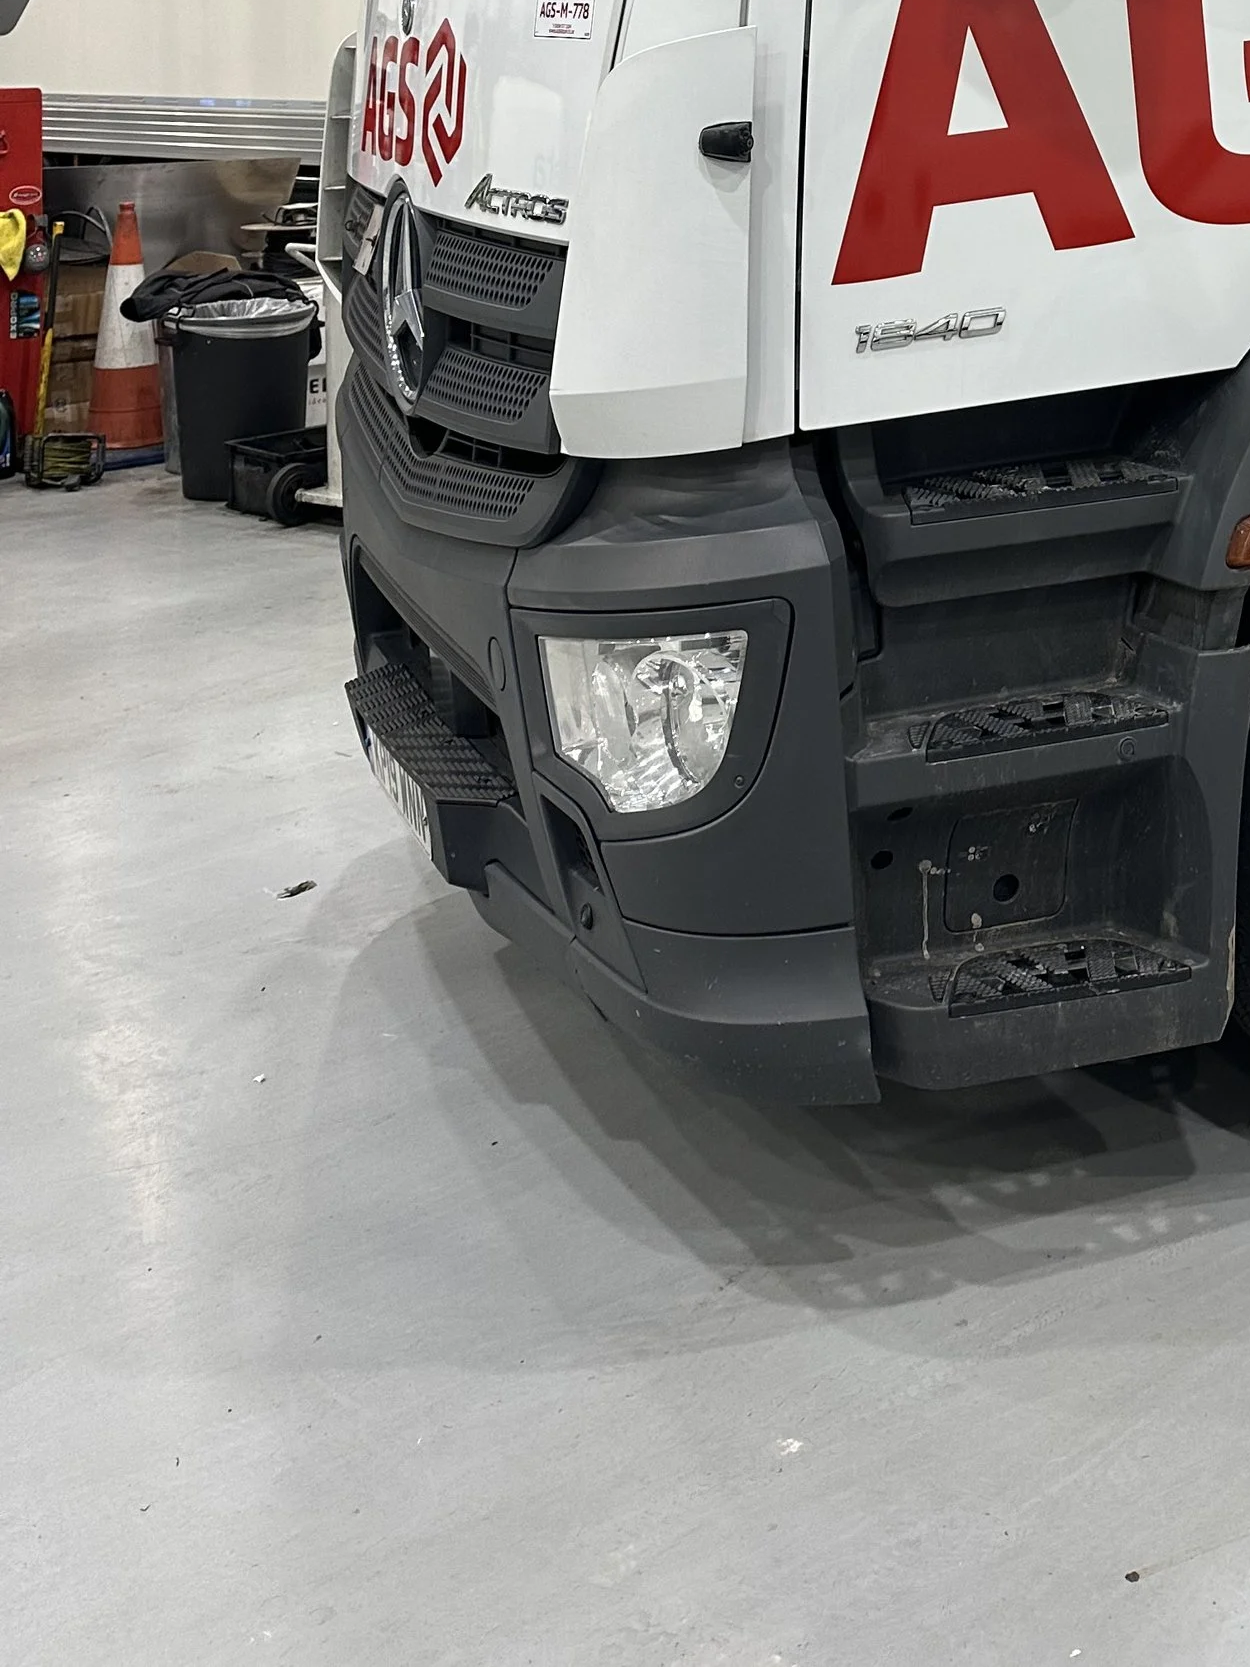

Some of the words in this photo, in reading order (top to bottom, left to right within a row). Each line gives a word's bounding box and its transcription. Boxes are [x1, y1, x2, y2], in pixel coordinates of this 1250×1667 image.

[539, 1, 590, 19] AGS-M-778
[361, 35, 421, 167] AGS
[855, 306, 1006, 354] 1840
